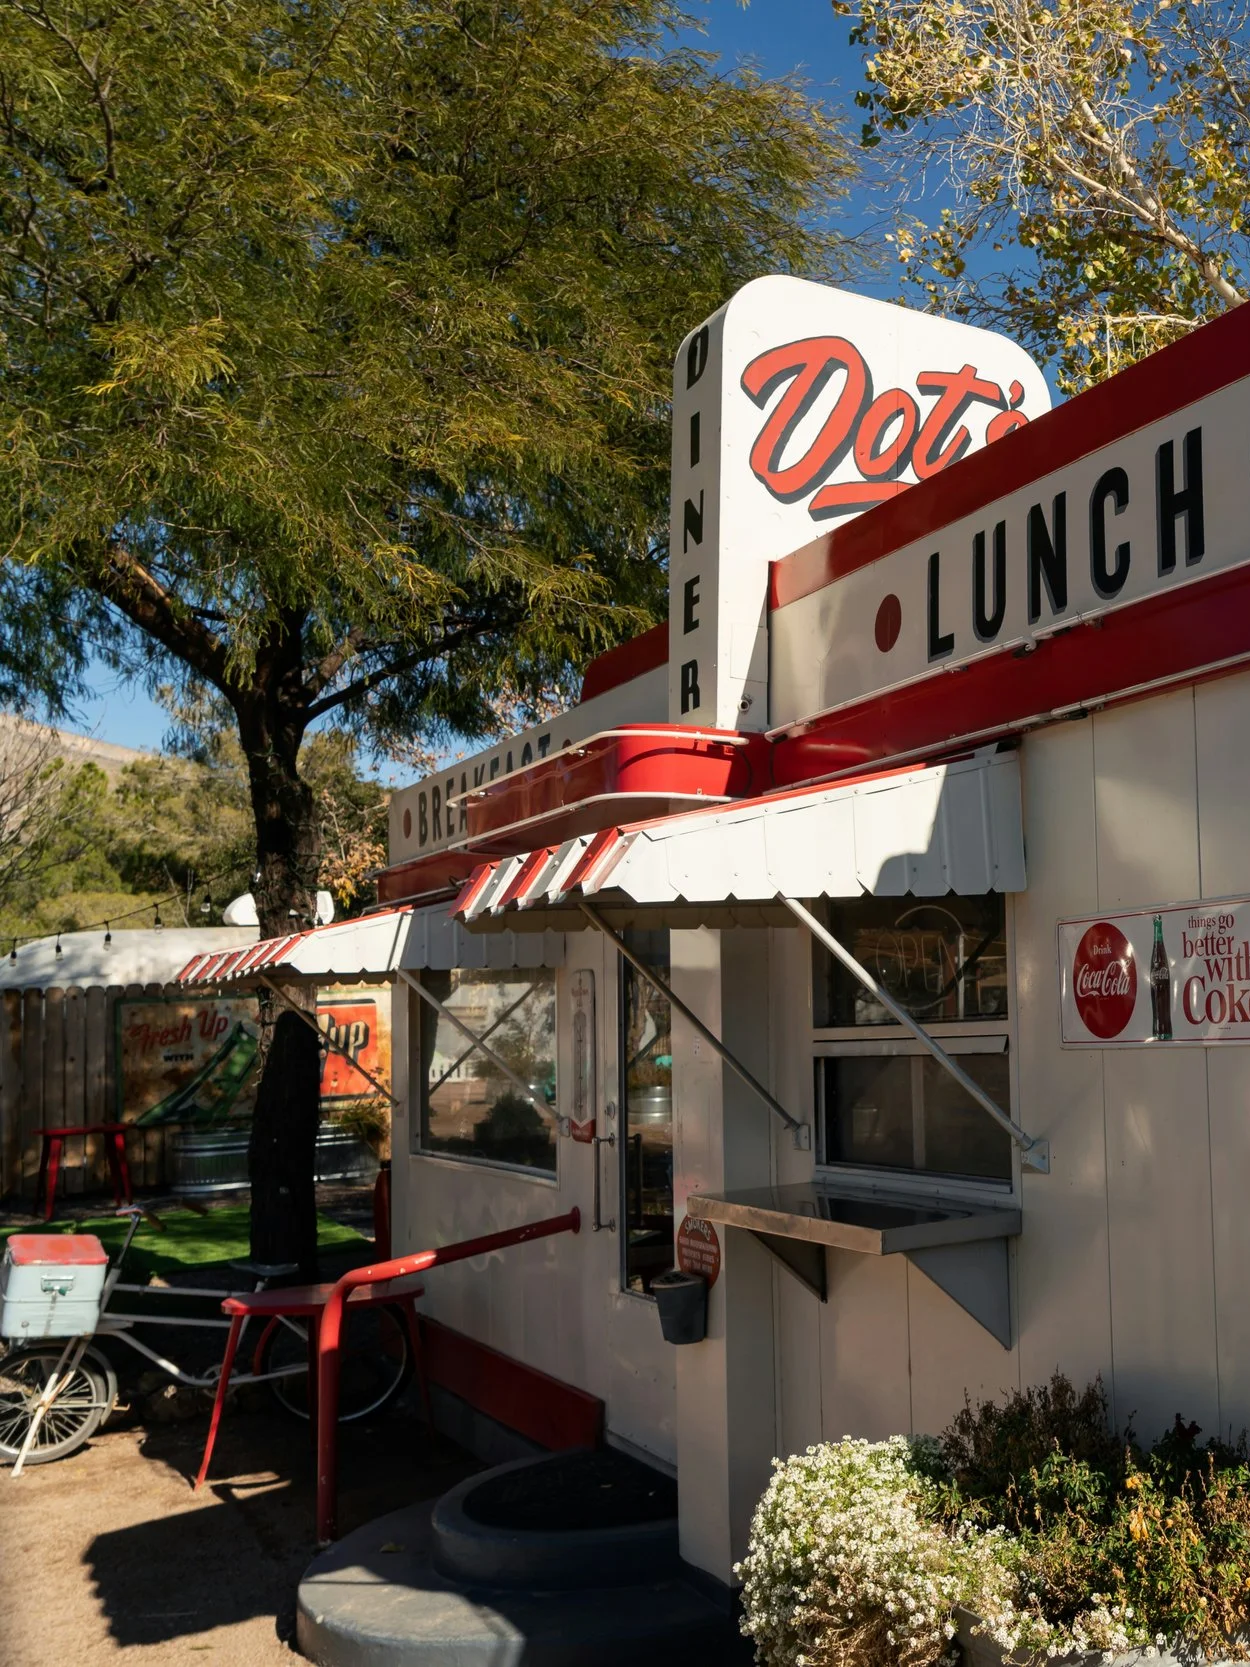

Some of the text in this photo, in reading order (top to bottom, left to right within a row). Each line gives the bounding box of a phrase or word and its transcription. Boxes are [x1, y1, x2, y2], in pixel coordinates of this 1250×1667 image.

[680, 325, 709, 715] DINER
[927, 426, 1205, 663] LUNCH
[1188, 914, 1234, 934] things go
[1093, 944, 1112, 956] Drink
[1182, 931, 1235, 959] better
[129, 1009, 230, 1050] Fresh Up
[163, 1052, 195, 1063] WITH
